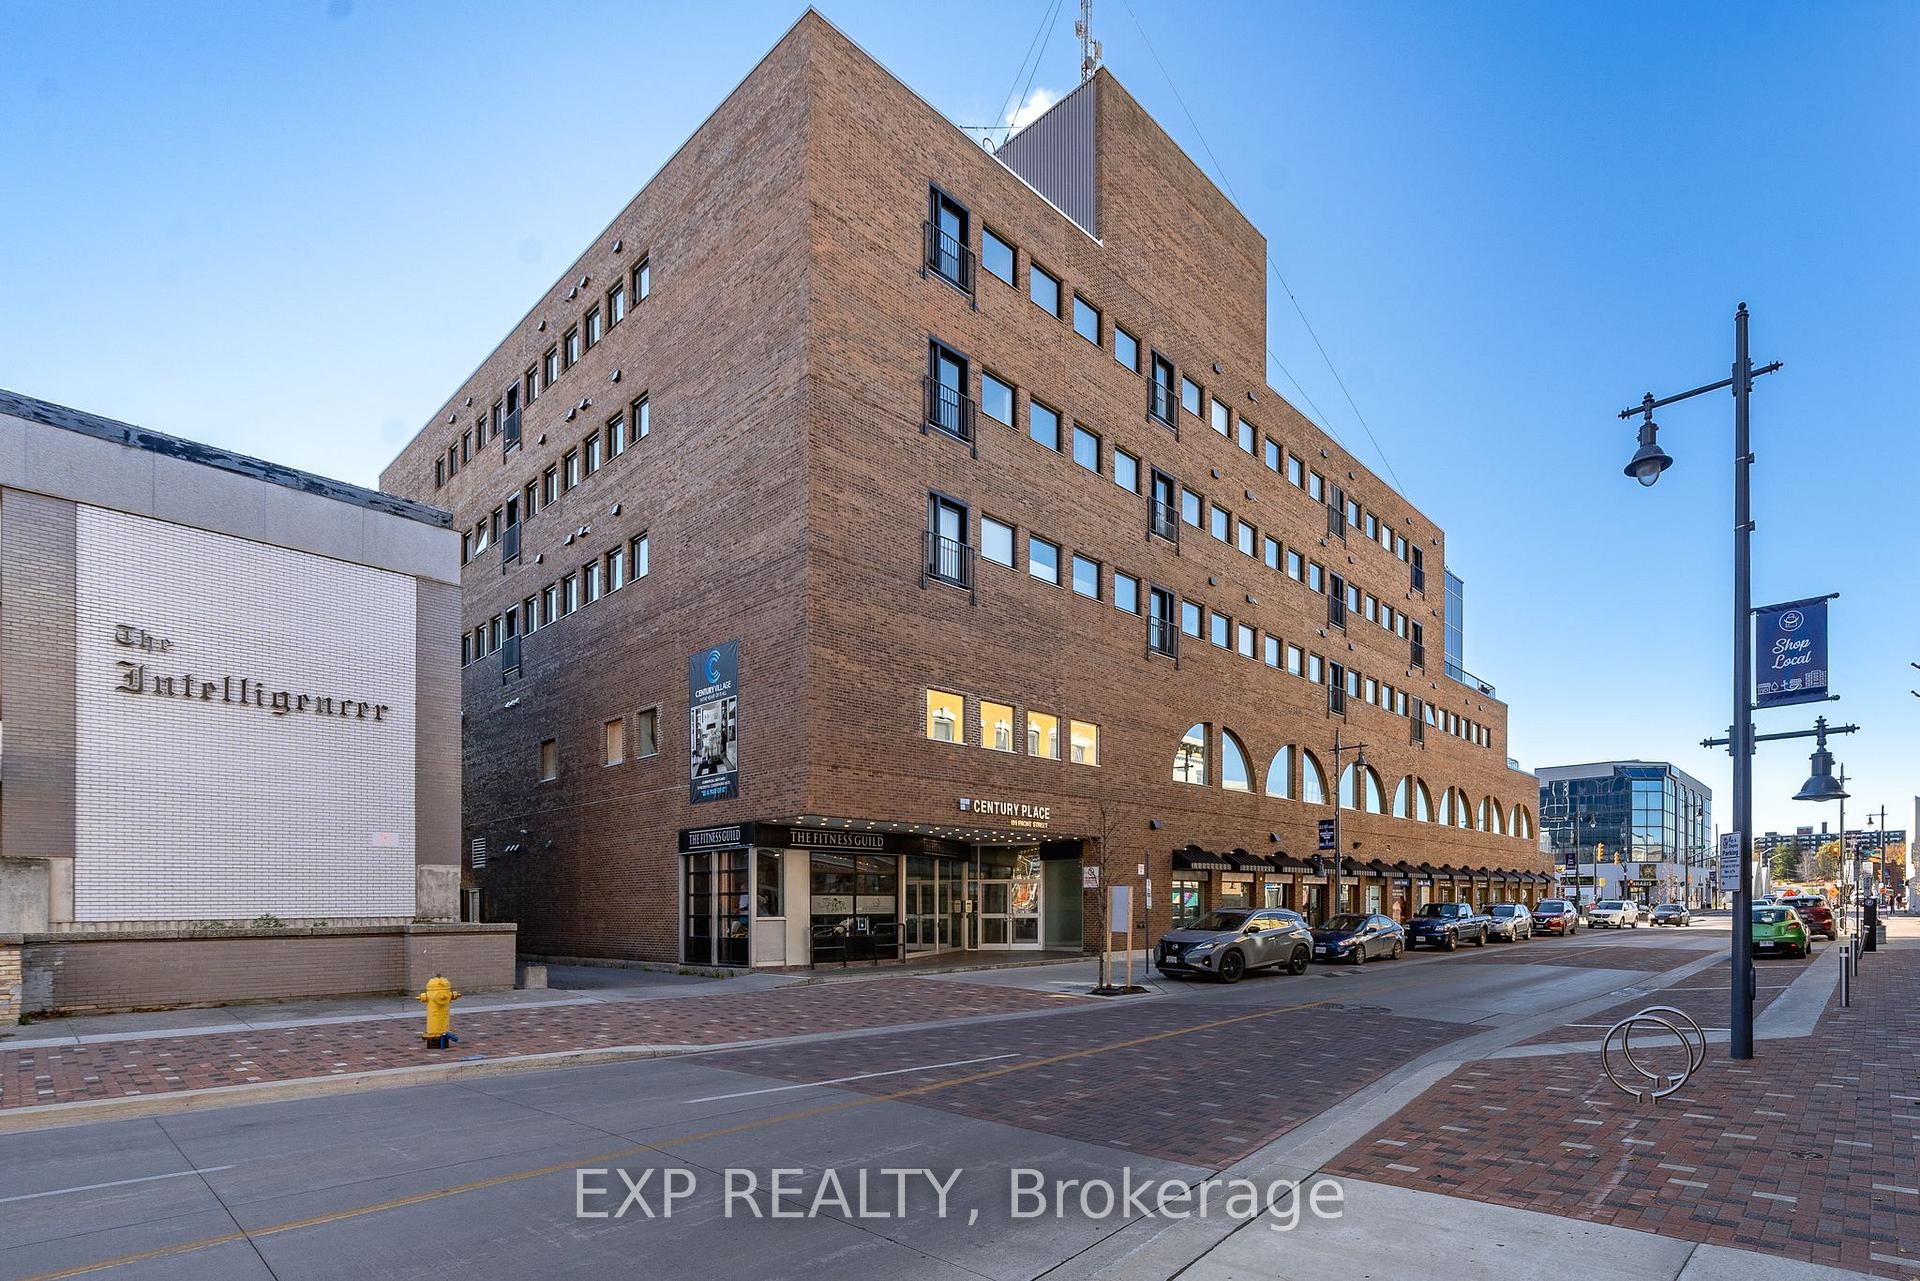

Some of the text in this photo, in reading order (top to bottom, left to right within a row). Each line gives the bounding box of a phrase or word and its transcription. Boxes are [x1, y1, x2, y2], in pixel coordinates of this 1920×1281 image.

[115, 624, 175, 652] The
[1772, 638, 1811, 654] Shop
[1771, 651, 1812, 669] Local
[115, 659, 389, 720] Intelligencer
[973, 800, 1050, 820] CENTURY PLACE
[1018, 820, 1032, 828] FRONT
[1032, 821, 1048, 829] STREET
[689, 829, 741, 845] THE FITNESS GUILD
[790, 831, 884, 847] THE FITNESS GUILD
